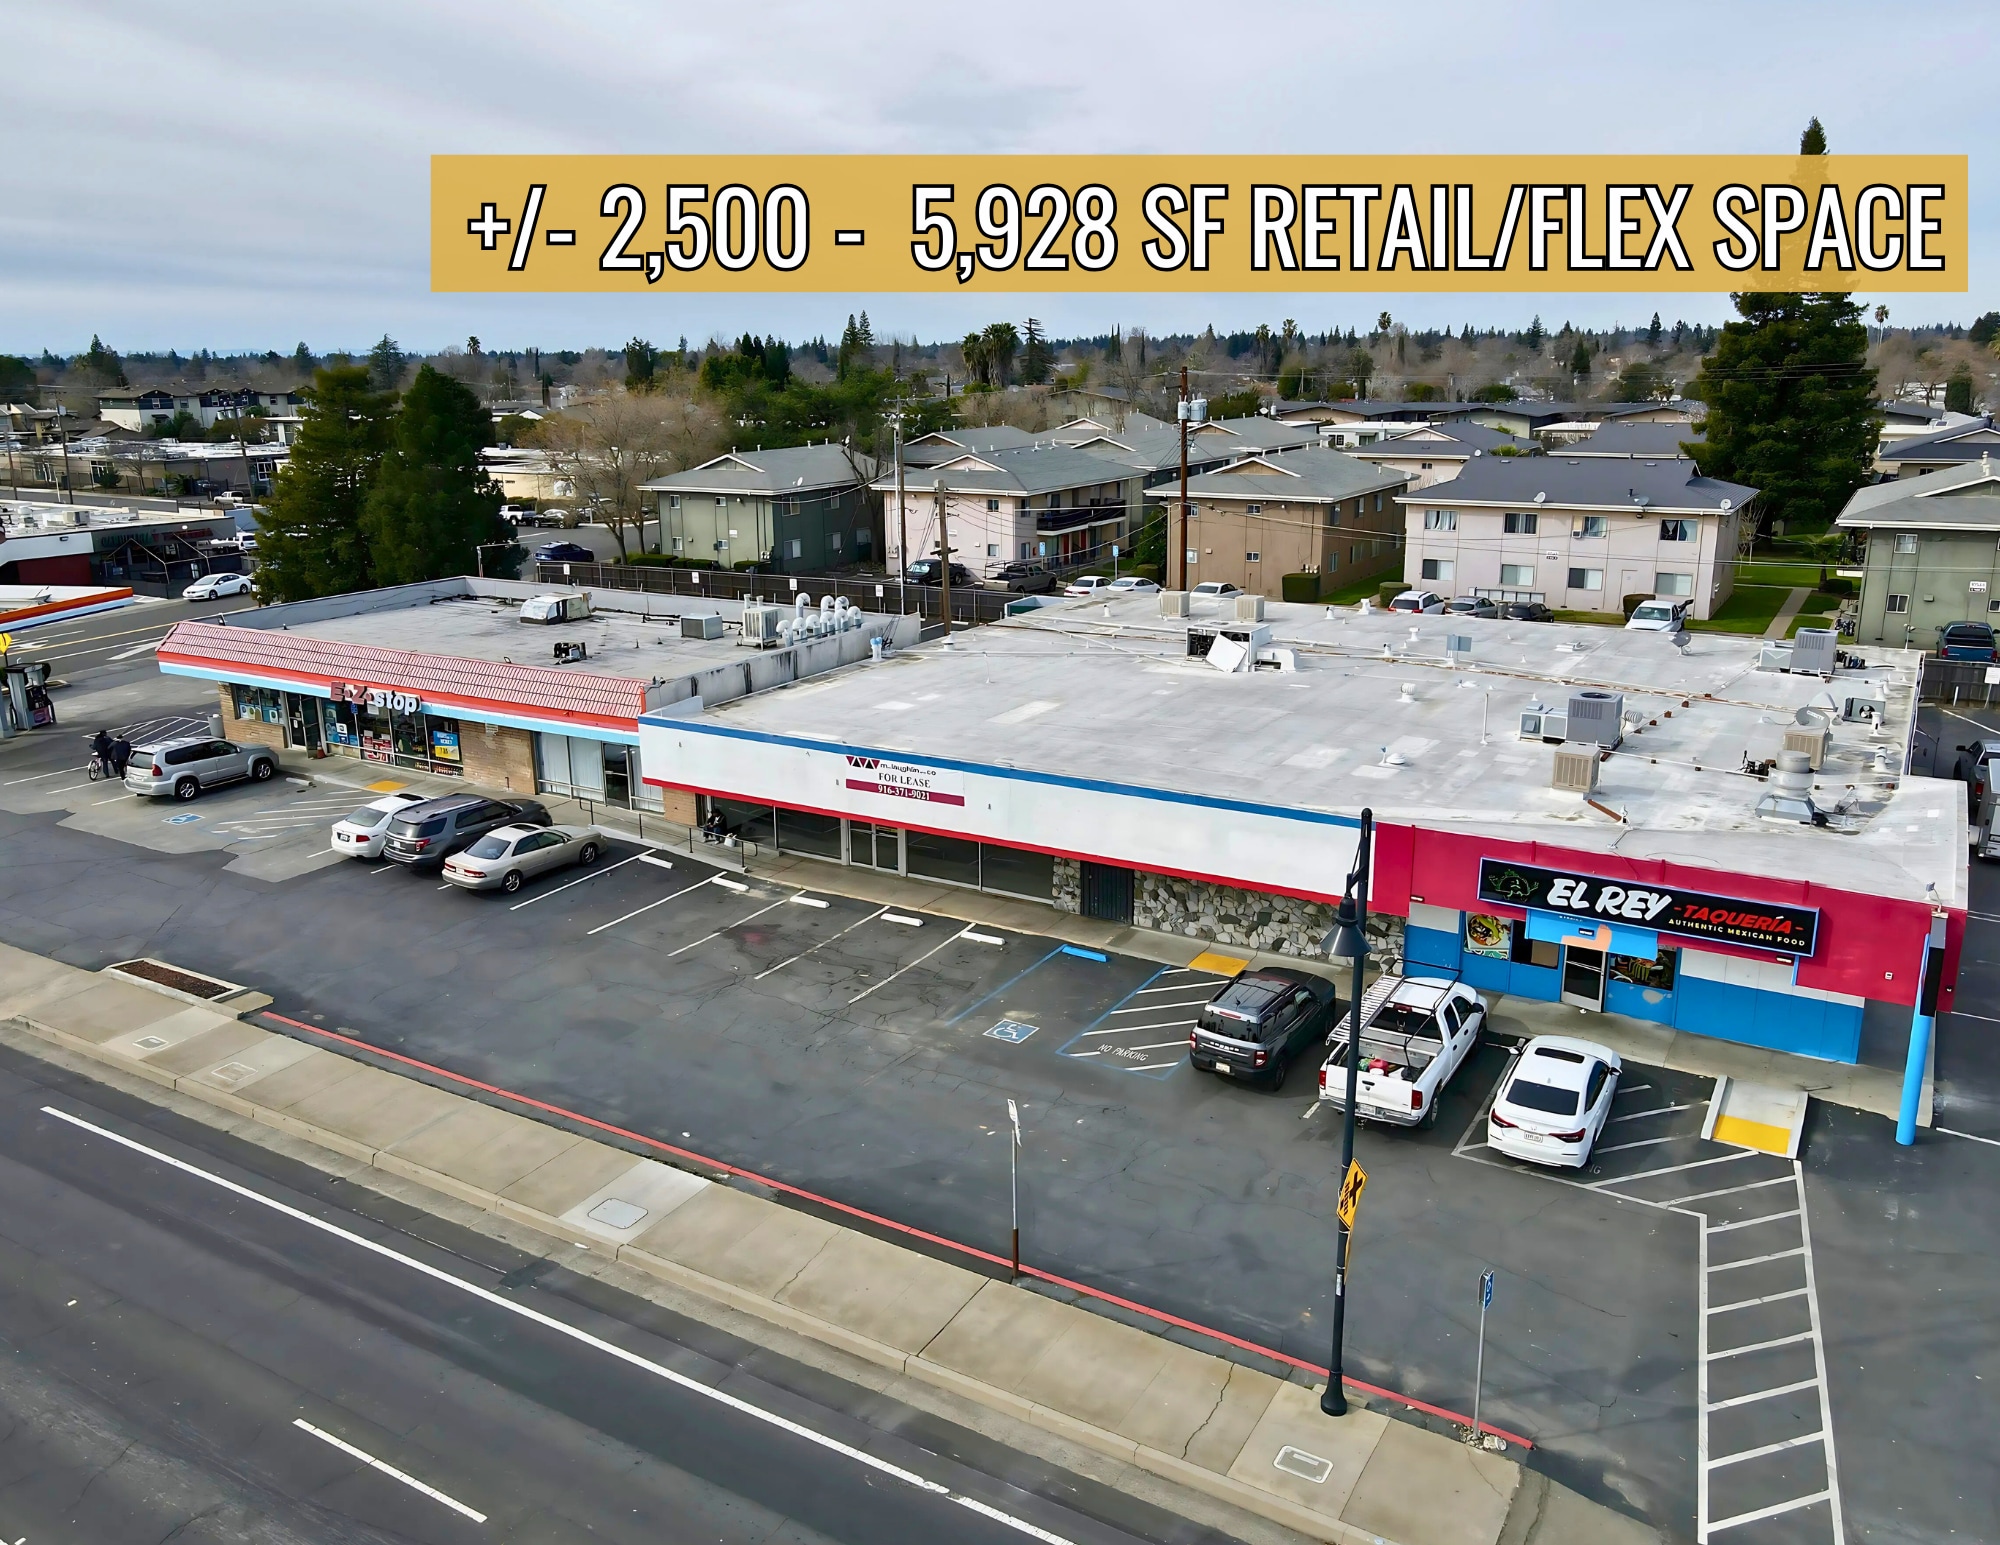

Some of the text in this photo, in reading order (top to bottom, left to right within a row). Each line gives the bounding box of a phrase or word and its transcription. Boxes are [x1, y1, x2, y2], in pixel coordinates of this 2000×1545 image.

[879, 772, 931, 788] FOR LEASE
[878, 784, 930, 801] 916-371-9021
[1546, 878, 1673, 921] EL REY
[1668, 918, 1805, 946] AUTHENTIC MEXICAN FOOD
[1097, 1043, 1149, 1061] NO PARKING
